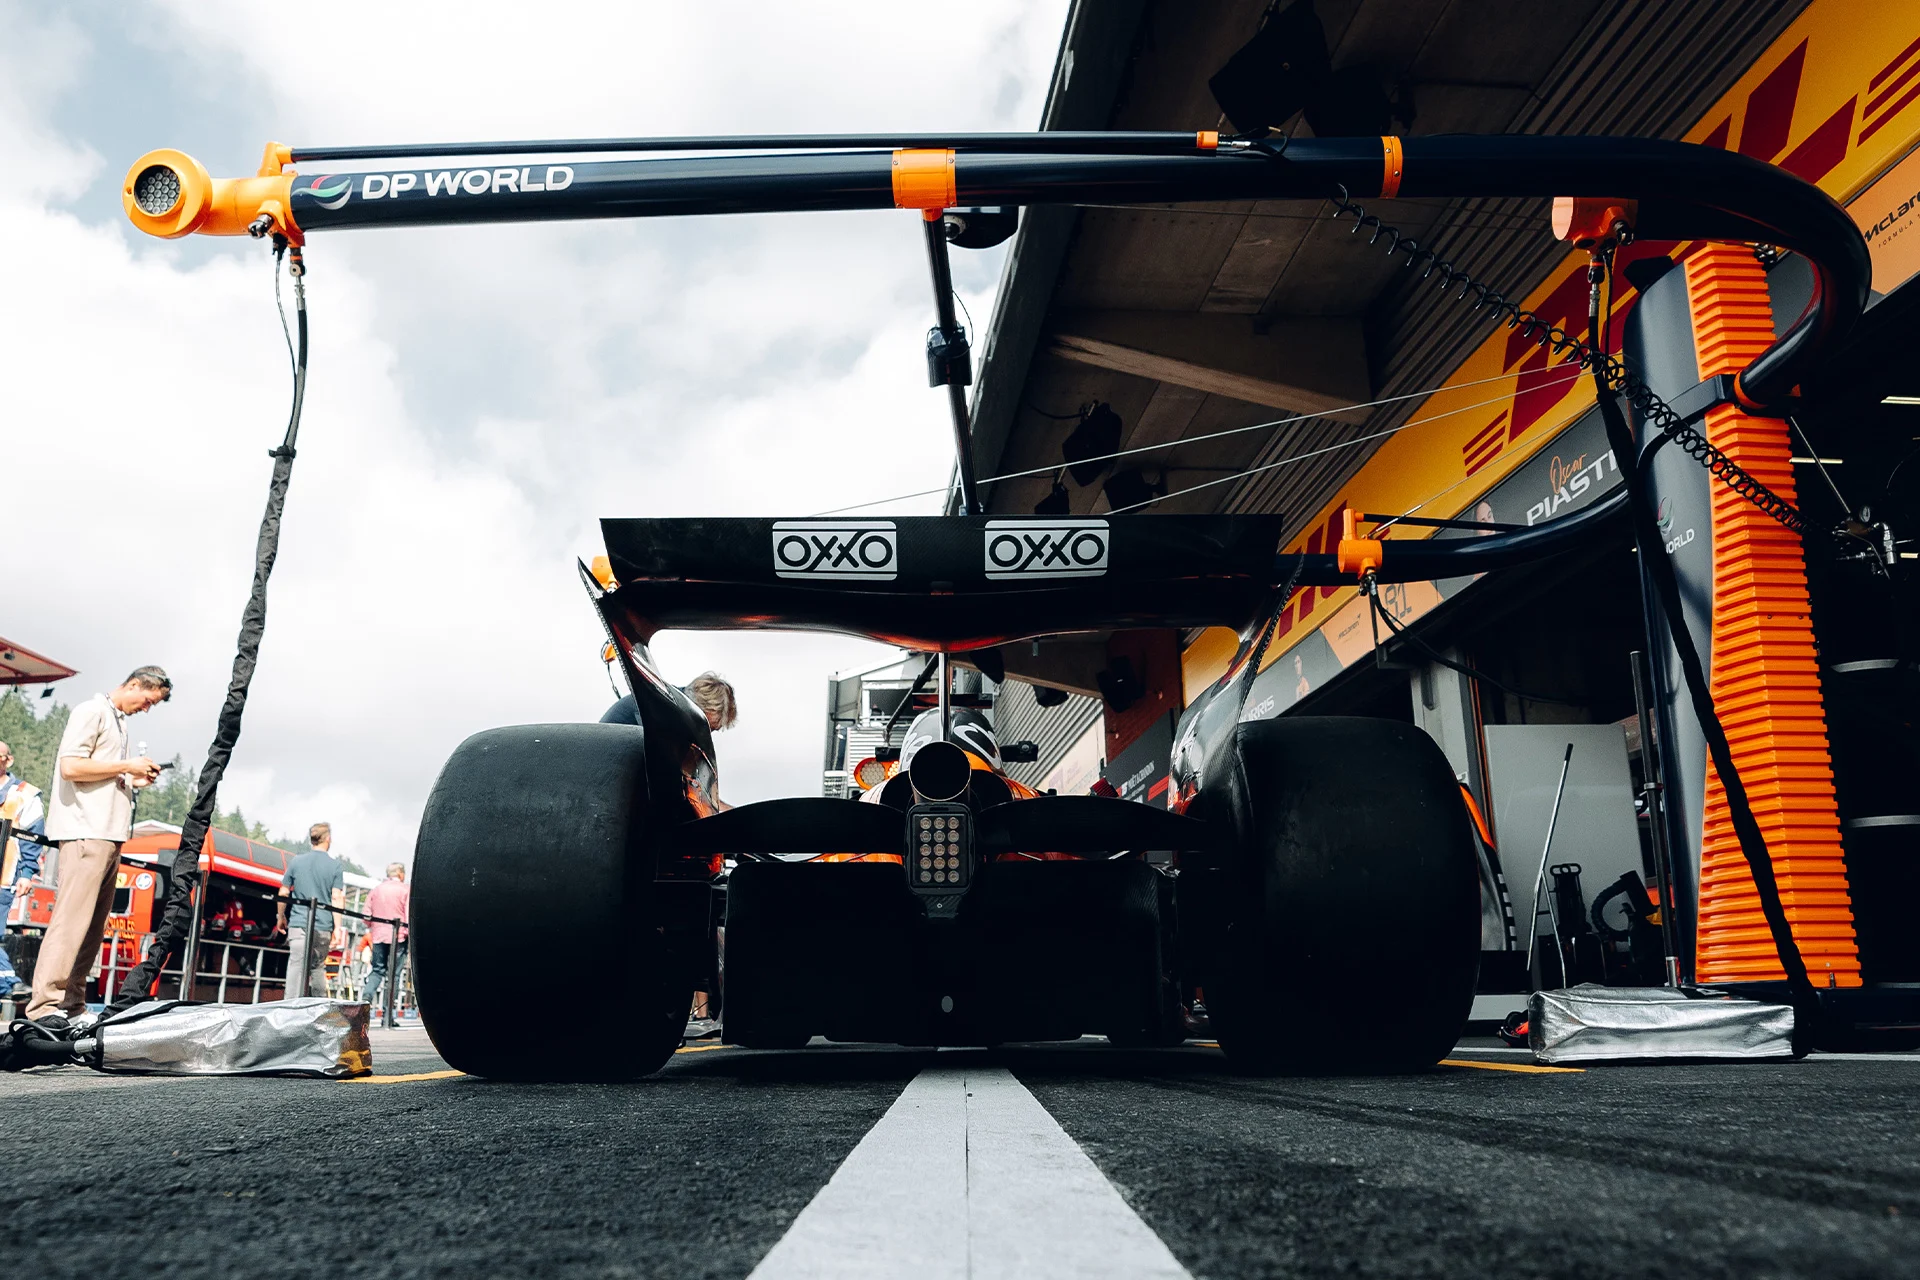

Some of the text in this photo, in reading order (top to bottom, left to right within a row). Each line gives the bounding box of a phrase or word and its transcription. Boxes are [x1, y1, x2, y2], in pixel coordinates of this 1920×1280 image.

[362, 166, 575, 200] DP WORLD
[1878, 219, 1914, 248] FORMULA
[1550, 453, 1588, 494] Oscar
[777, 530, 893, 571] OXXO
[989, 529, 1105, 570] OXXO
